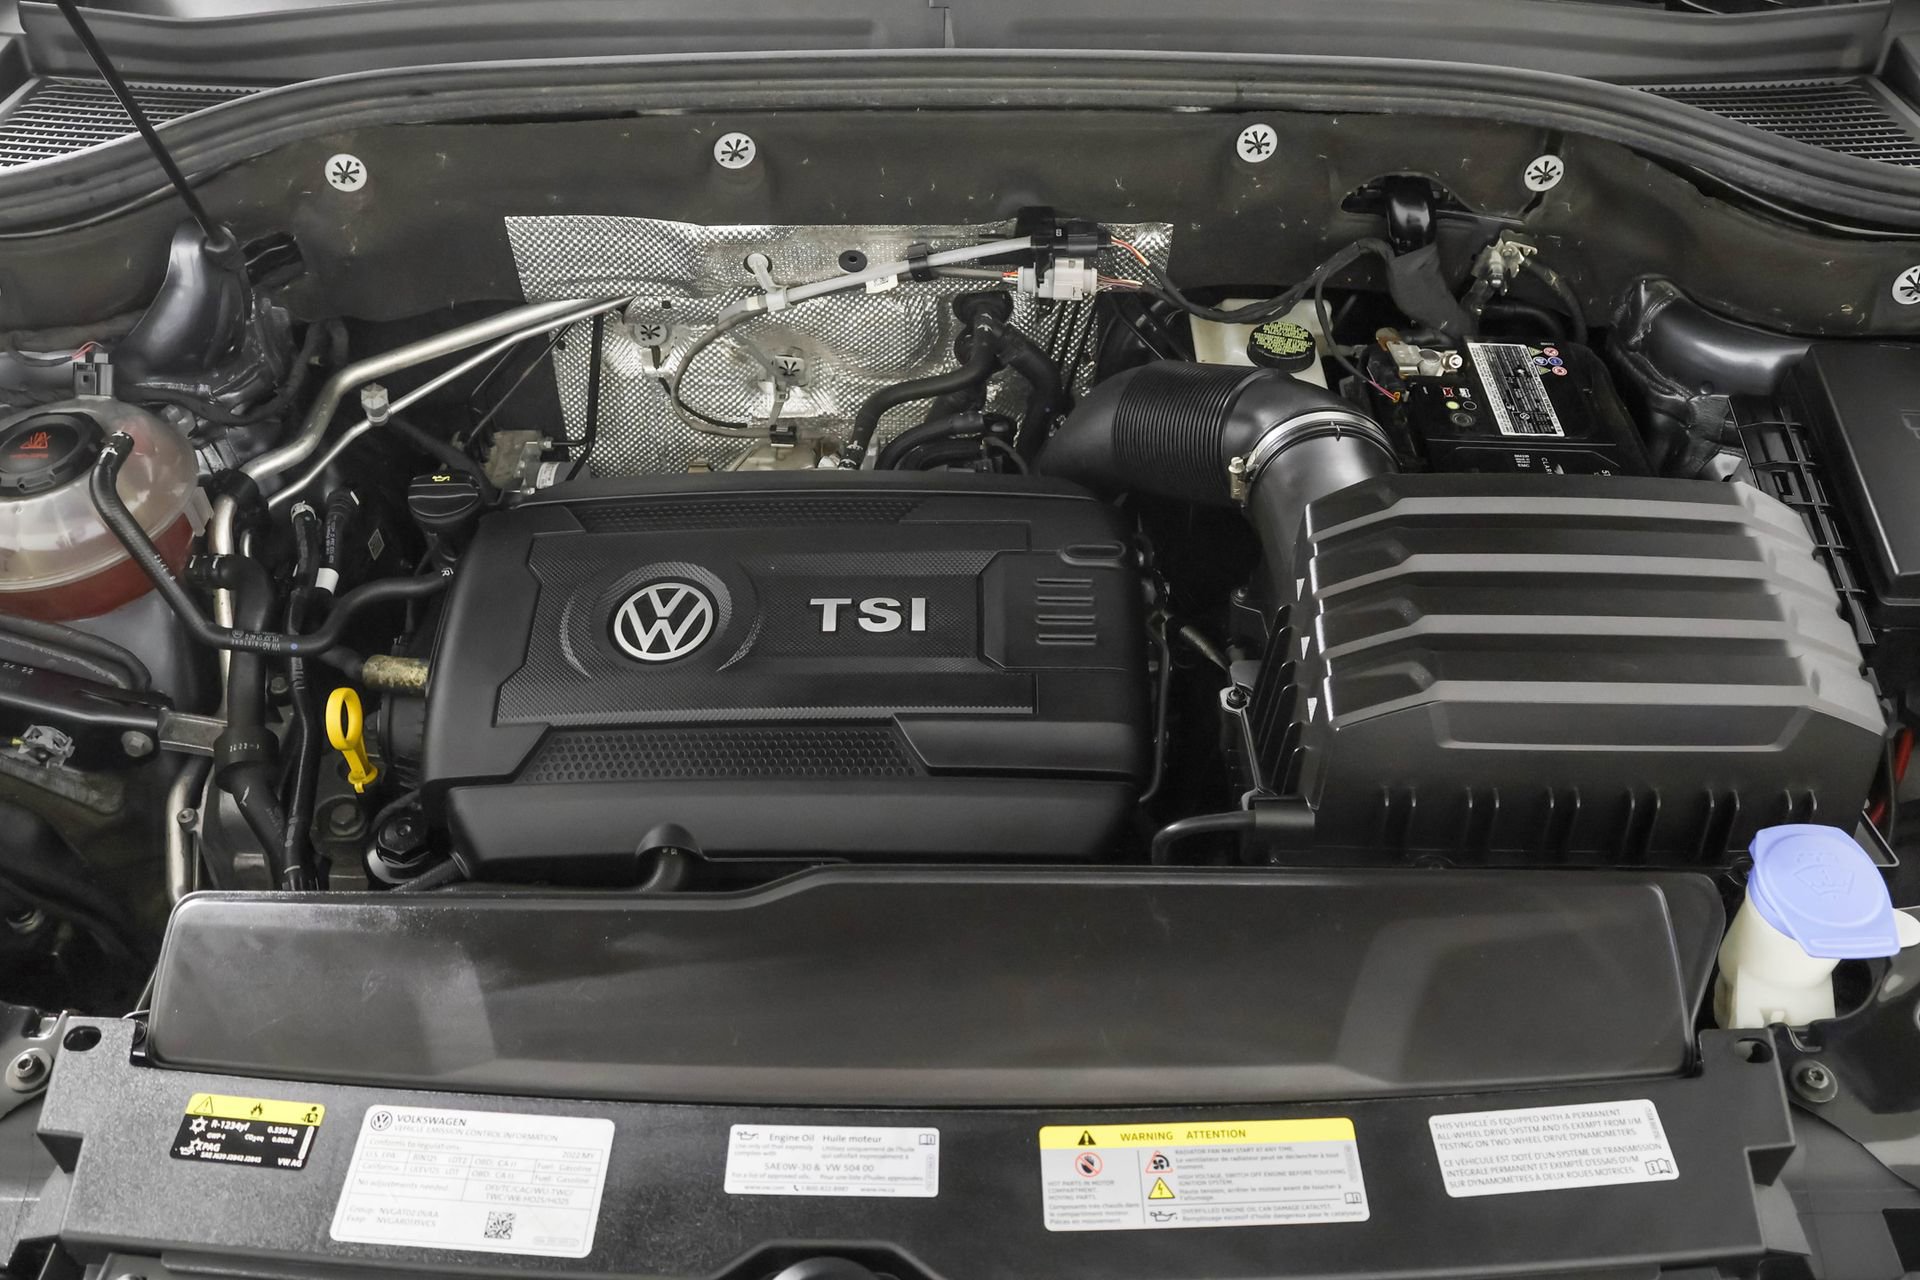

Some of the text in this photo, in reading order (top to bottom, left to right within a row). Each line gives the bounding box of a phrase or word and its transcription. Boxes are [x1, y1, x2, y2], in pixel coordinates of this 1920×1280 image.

[810, 597, 926, 632] TSI
[613, 582, 714, 661] VW
[211, 1119, 250, 1133] R-1234yf
[397, 1114, 467, 1127] VOLKSWAGEN
[1434, 1122, 1453, 1131] THIS
[1454, 1120, 1488, 1129] VEHICLE
[1499, 1115, 1539, 1126] EQUIPPED
[1541, 1113, 1563, 1121] WITH
[1572, 1109, 1621, 1119] PERMANENT
[1483, 1128, 1508, 1137] DRIVE
[1510, 1125, 1540, 1135] SYSTEM
[1542, 1123, 1560, 1132] AND
[1562, 1122, 1569, 1130] IS
[1571, 1120, 1602, 1130] EXEMPT
[1603, 1118, 1626, 1127] FROM
[503, 1131, 559, 1142] INFORMATION
[769, 1134, 815, 1143] Engine Oil
[823, 1135, 882, 1143] Huile moteur
[1120, 1129, 1246, 1142] WARNING ATTENTION
[1440, 1141, 1474, 1150] TESTING
[1475, 1140, 1489, 1148] ON
[1543, 1133, 1568, 1143] DRIVE
[1496, 1155, 1509, 1163] EST
[1603, 1143, 1662, 1154] TRANSMISSION
[277, 1158, 303, 1168] VW AG
[764, 1163, 781, 1171] SAE
[1490, 1163, 1537, 1174] PERMANENT
